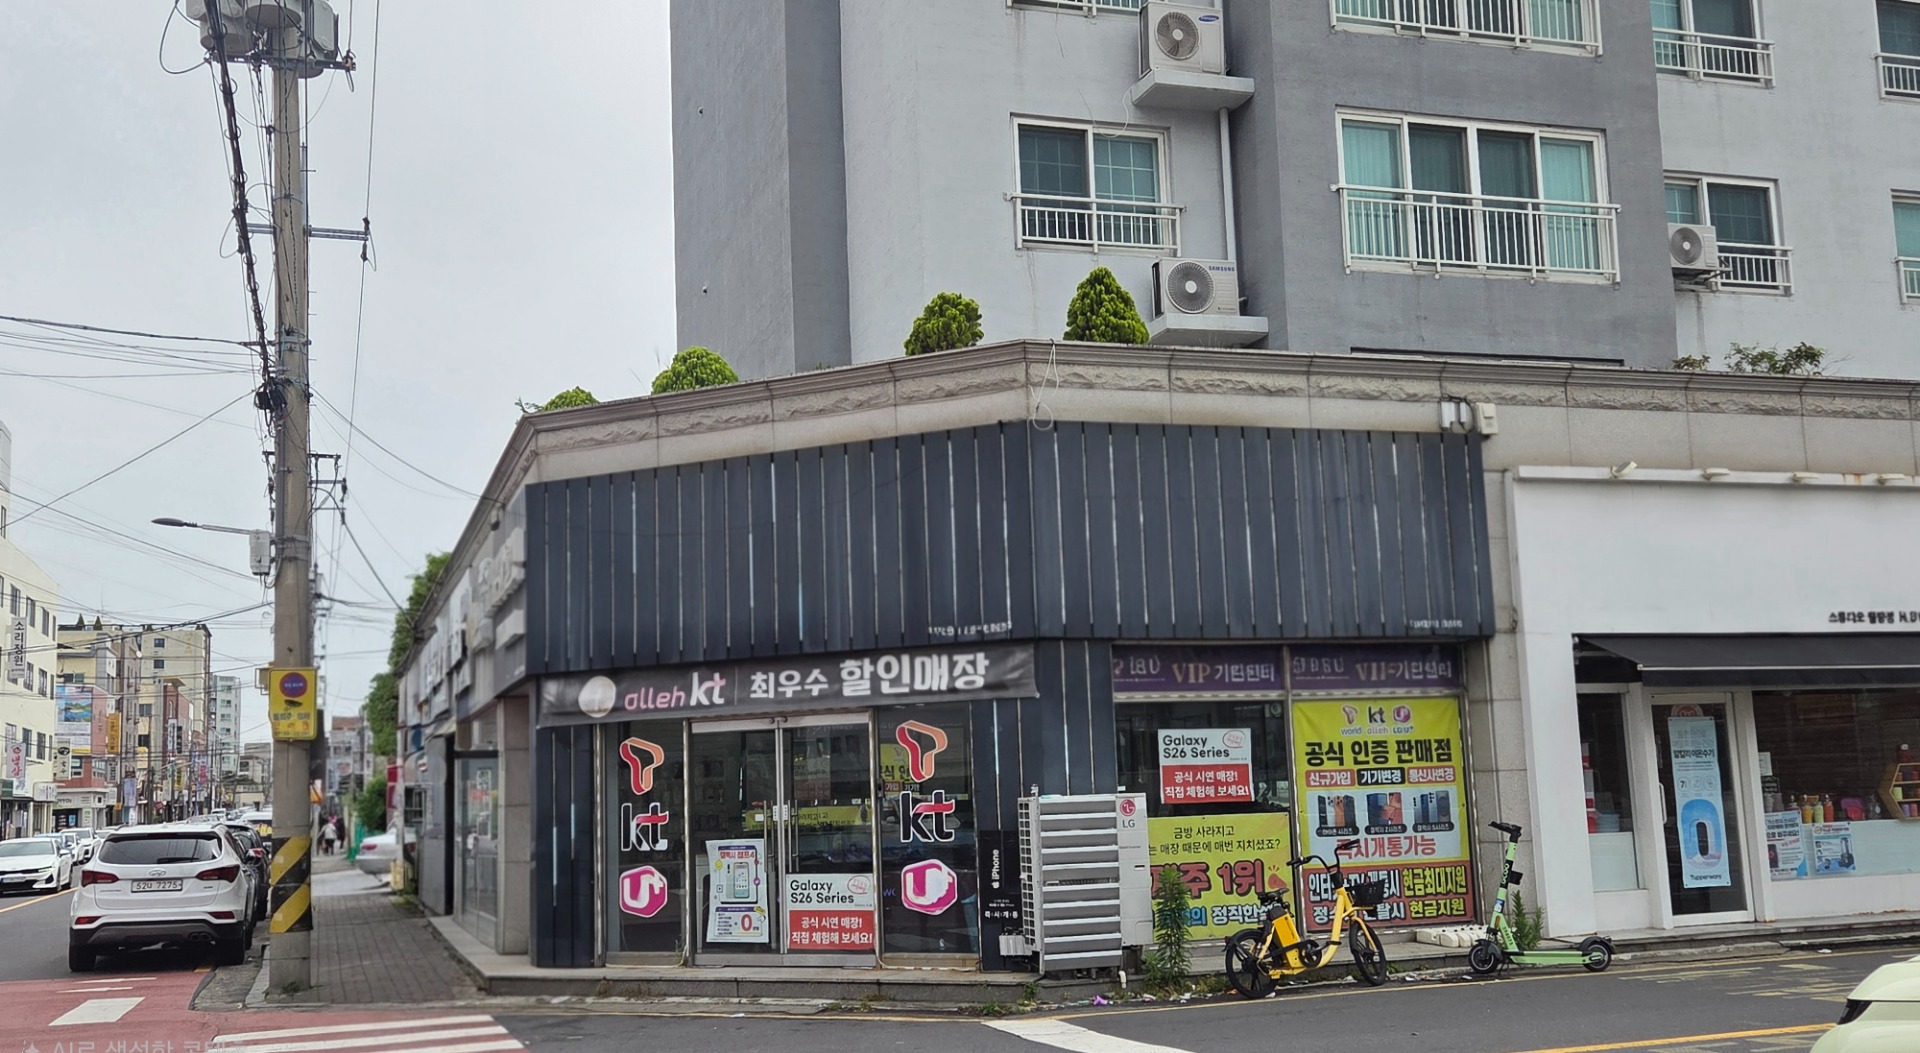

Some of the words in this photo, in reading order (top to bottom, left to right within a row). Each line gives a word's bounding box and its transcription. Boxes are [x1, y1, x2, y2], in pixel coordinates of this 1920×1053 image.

[13, 620, 25, 667] 소리정원
[689, 671, 726, 707] kt
[750, 667, 829, 699] 최우수
[840, 652, 990, 697] 할인매장
[1172, 662, 1211, 684] VIP
[1163, 734, 1208, 749] Galaxy
[1163, 747, 1187, 759] S26
[1190, 746, 1230, 759] Series
[1305, 742, 1345, 767] 공식
[1350, 740, 1389, 765] 인증
[1395, 738, 1453, 764] 판매점
[1174, 770, 1193, 783] 공식
[1195, 770, 1215, 783] 시연
[1216, 770, 1238, 783] 매장!
[1309, 771, 1352, 786] 신규가입
[1360, 769, 1402, 784] 기기변경
[1408, 767, 1455, 782] 통신사변경
[1164, 785, 1185, 799] 직접
[1186, 785, 1215, 798] 체험해
[1217, 784, 1250, 797] 보세요!
[900, 790, 955, 842] kt
[621, 802, 669, 851] kt
[1122, 819, 1136, 829] LG
[1173, 827, 1193, 840] 금방
[1195, 825, 1235, 838] 사라지고
[1160, 843, 1179, 855] 매장
[1182, 840, 1212, 854] 때문에
[1214, 840, 1234, 853] 매번
[156, 881, 178, 889] 7275
[1216, 858, 1266, 897] 1위
[1402, 865, 1467, 897] 현금최대지원
[790, 879, 833, 894] Galaxy
[790, 892, 813, 904] S26
[816, 891, 854, 904] Series
[1409, 897, 1465, 920] 현금지원
[801, 916, 819, 929] 공식
[821, 916, 839, 929] 시연
[840, 916, 862, 929] 매장!
[791, 931, 810, 945] 직접
[811, 931, 839, 945] 체험해
[841, 932, 873, 944] 보세요!
